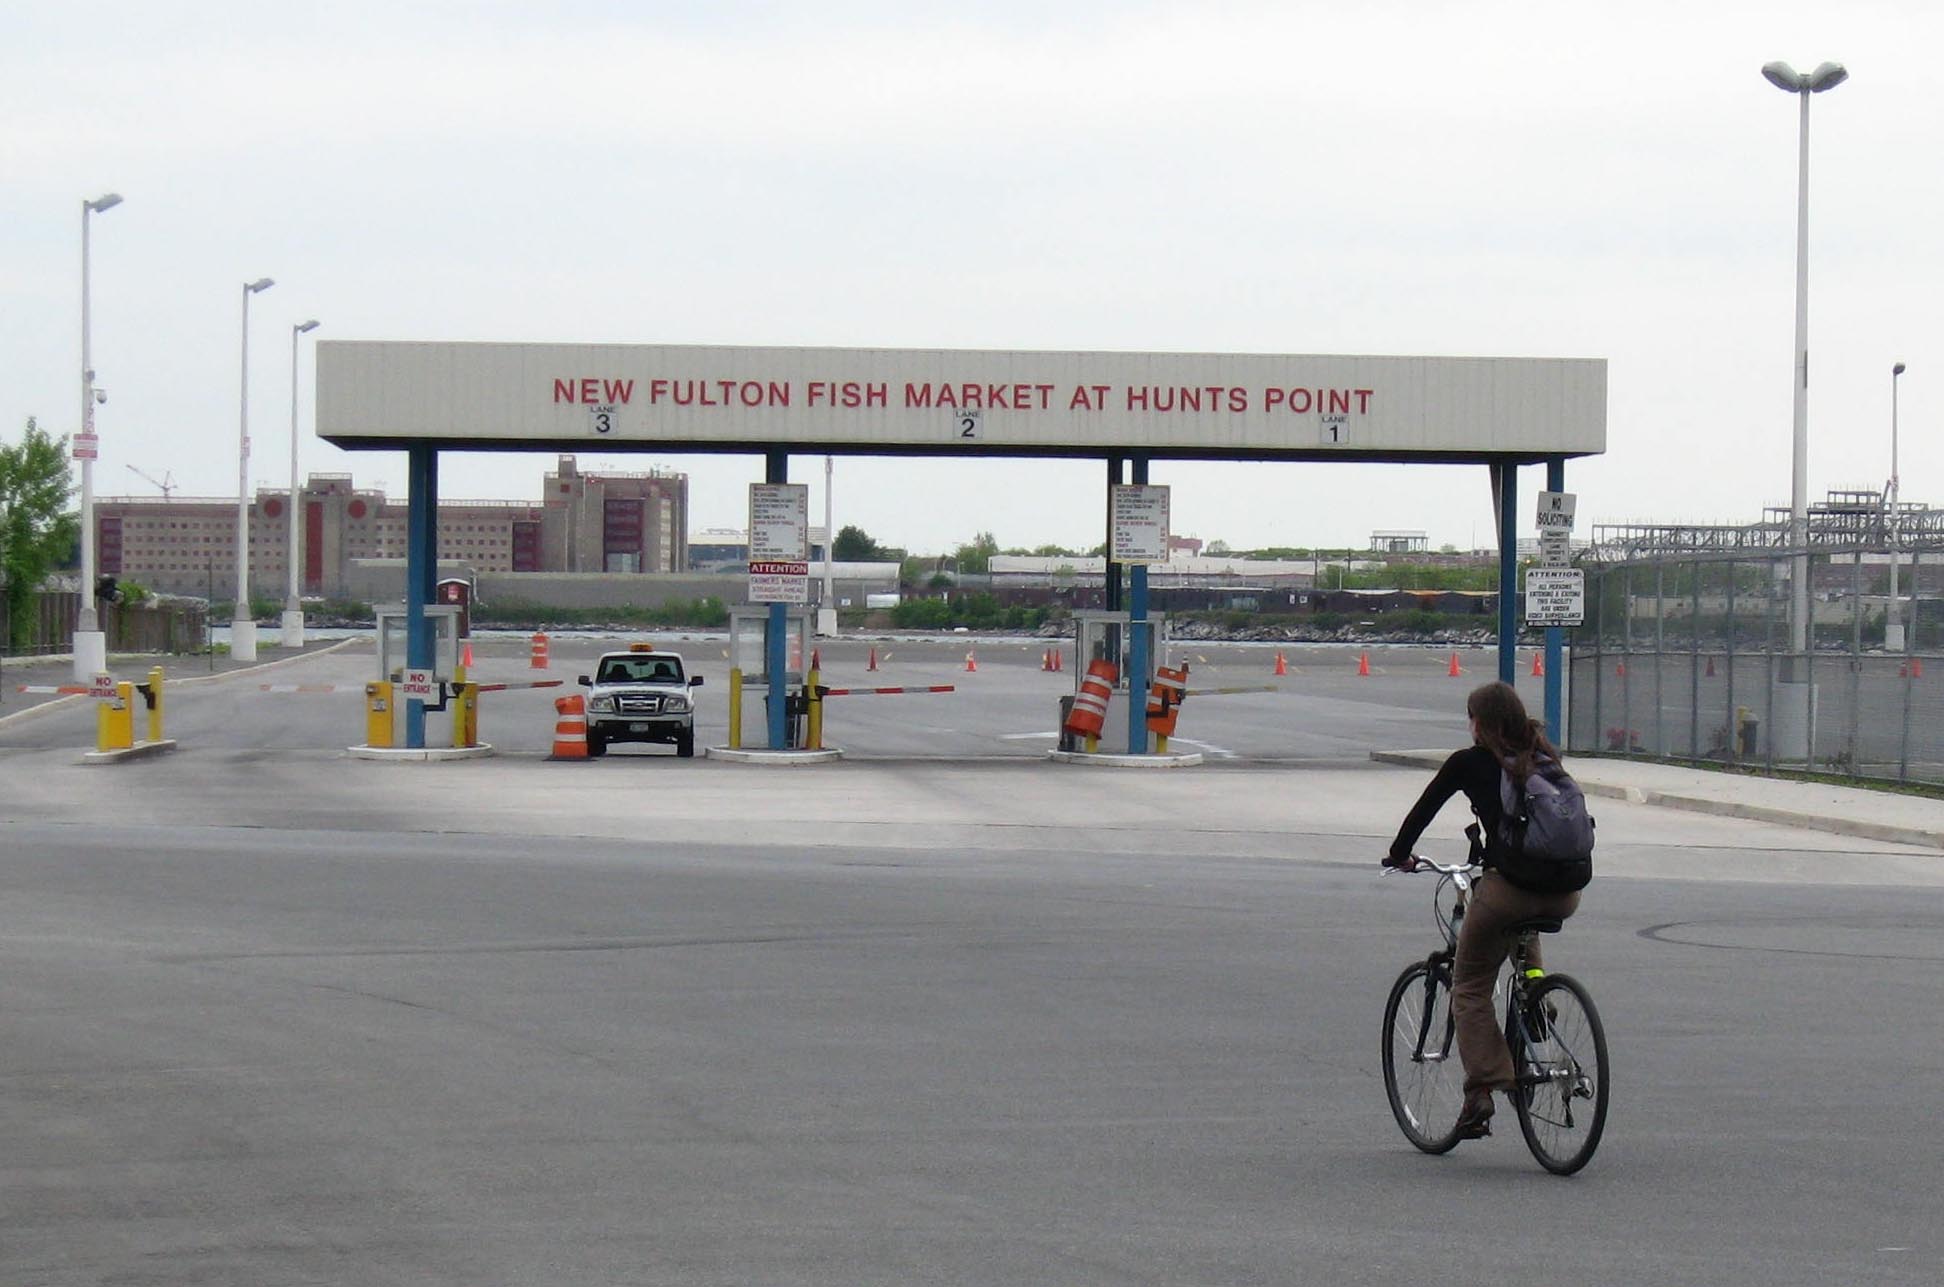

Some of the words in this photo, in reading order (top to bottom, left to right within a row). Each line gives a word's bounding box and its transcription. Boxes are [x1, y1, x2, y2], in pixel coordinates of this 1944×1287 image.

[553, 378, 635, 405] NEW
[651, 379, 790, 407] FULTON
[807, 381, 888, 408] FISH
[905, 383, 1055, 410] MARKET
[1069, 385, 1111, 411] AT
[1127, 386, 1248, 412] HUNTS
[1264, 388, 1374, 414] POINT
[596, 413, 611, 433] 3
[961, 418, 975, 437] 2
[1329, 425, 1339, 442] 1
[1552, 497, 1562, 511] NO
[1538, 512, 1572, 527] SOLICITING
[751, 563, 807, 574] ATTENTION
[782, 577, 805, 585] MARKET
[96, 677, 111, 686] NO
[410, 674, 425, 682] NO
[403, 684, 430, 694] ENTRANCE
